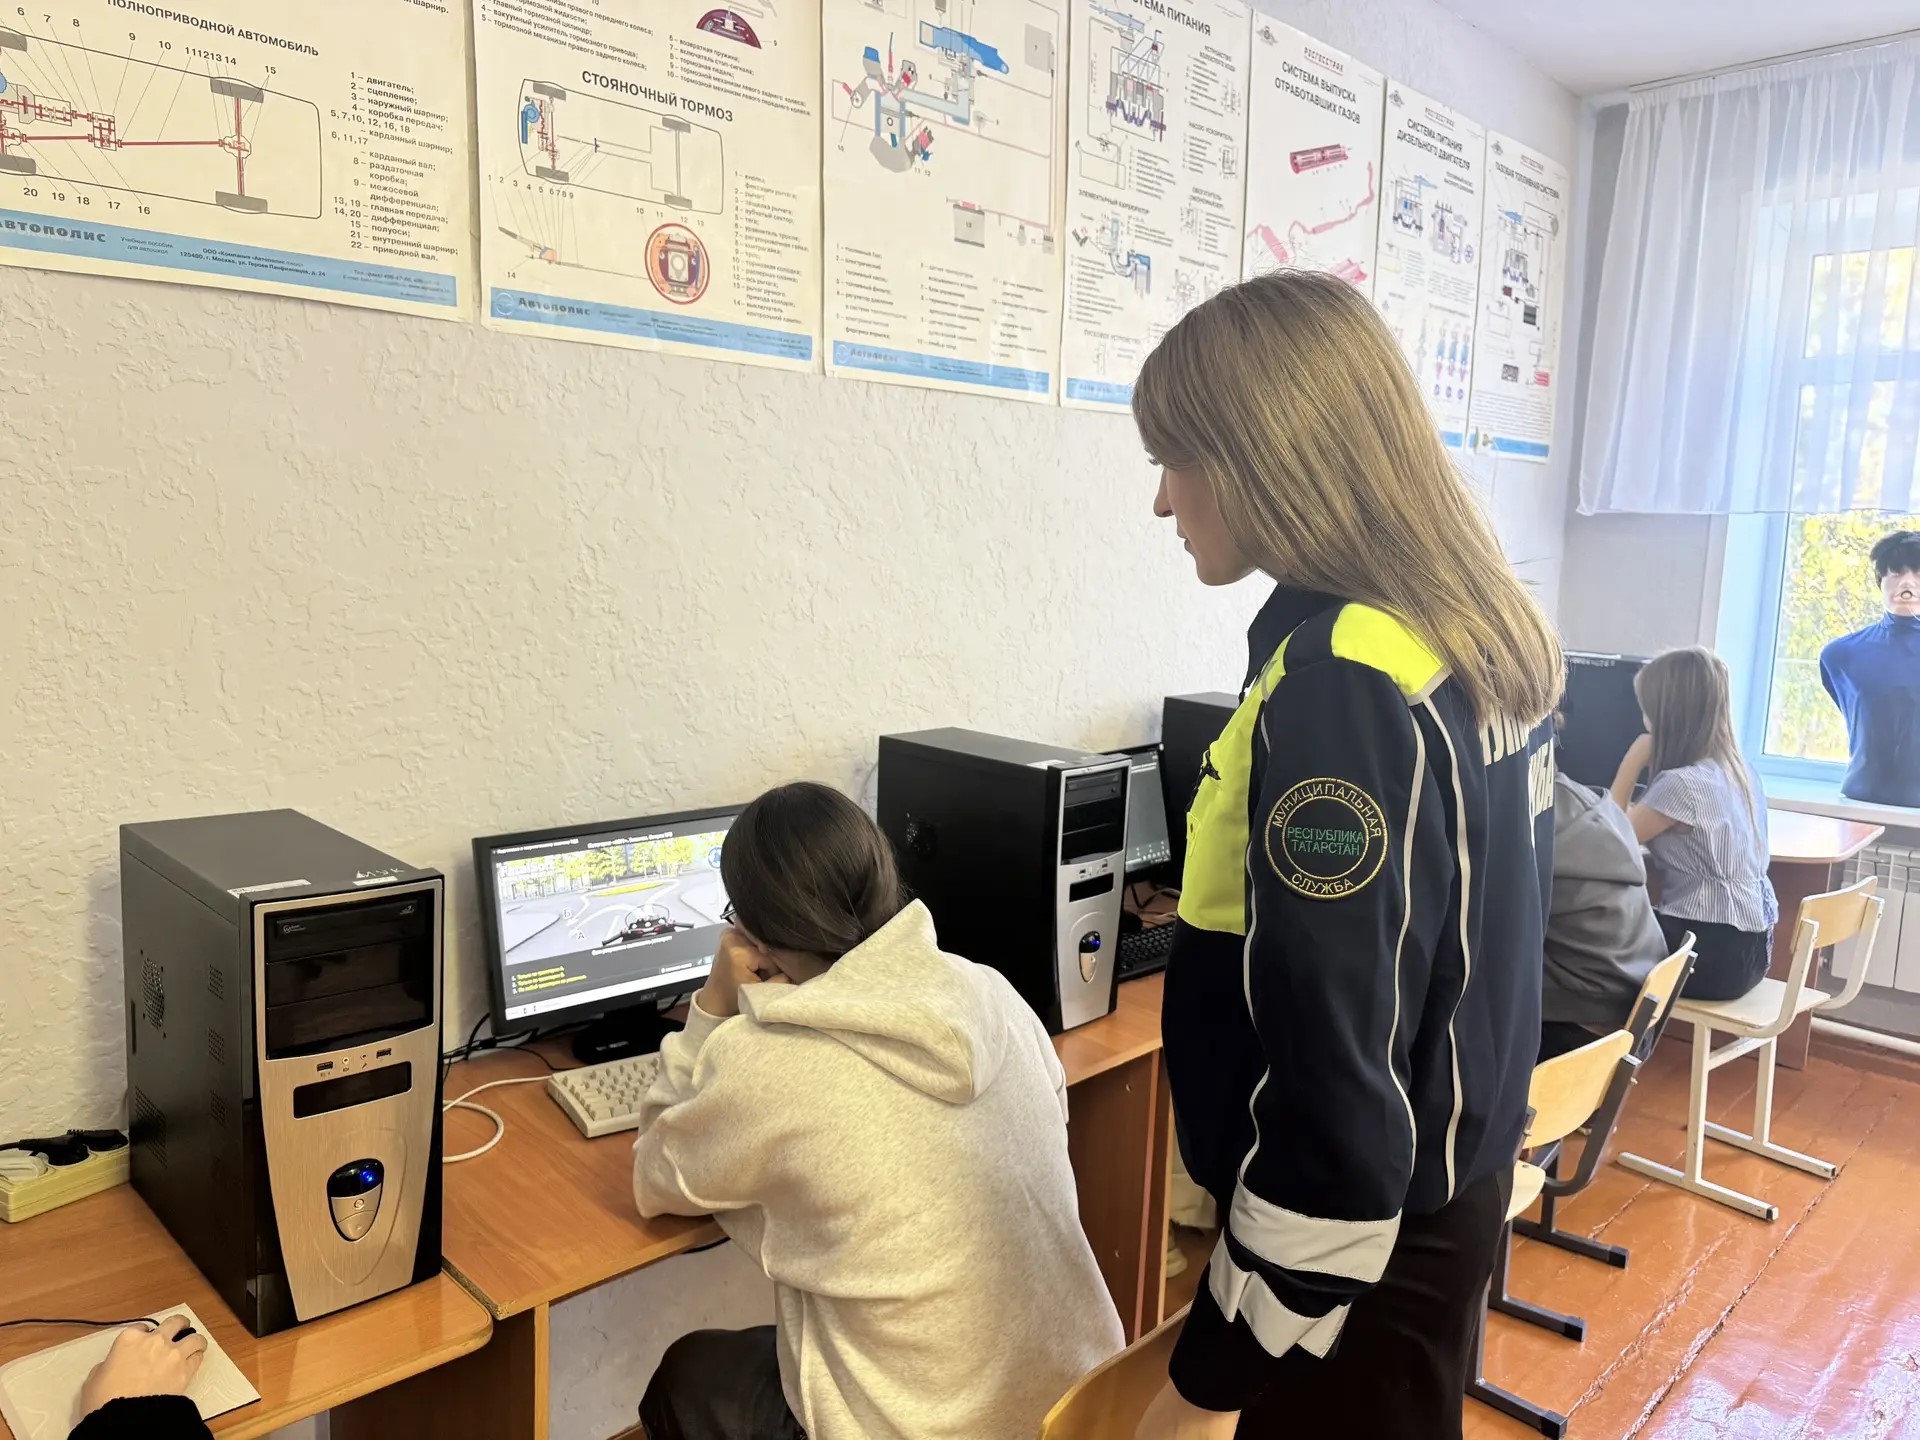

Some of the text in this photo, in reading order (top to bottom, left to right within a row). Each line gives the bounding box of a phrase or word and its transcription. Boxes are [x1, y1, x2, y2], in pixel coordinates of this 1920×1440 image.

[17, 7, 25, 16] 6
[43, 14, 51, 23] 7
[523, 9, 561, 25] тормозной
[72, 18, 80, 27] 8
[493, 9, 533, 26] вакуумный
[569, 32, 608, 50] тормозного
[1167, 7, 1212, 37] ПИТАНИЯ
[128, 32, 136, 41] 9
[158, 40, 172, 50] 10
[237, 29, 319, 57] АВТОМОБИЛЬ
[494, 19, 533, 37] тормозной
[533, 31, 567, 47] механизм
[567, 42, 595, 55] правого
[595, 51, 622, 63] заднего
[210, 53, 222, 62] 13
[225, 56, 237, 65] 14
[264, 65, 277, 75] 15
[366, 77, 414, 94] двигатель;
[1281, 61, 1357, 104] СИСТЕМА ВЫПУСКА
[350, 82, 418, 105] 2 сцепление;
[582, 70, 734, 123] СТОЯНОЧНЫЙ ТОРМОЗ
[1274, 77, 1361, 125] ОТРАБОТАВШИХ ГАЗОВ
[351, 92, 449, 123] 3 наружный шарнир;
[352, 103, 443, 132] 4 коробка передач;
[400, 125, 411, 133] 18
[368, 129, 453, 155] карданный шарнир;
[353, 157, 424, 178] 8 раздаточная
[369, 151, 436, 171] карданный вал;
[353, 178, 419, 198] 9 межосевой
[369, 172, 408, 186] коробка;
[23, 187, 38, 197] 20
[51, 192, 66, 202] 19
[76, 196, 90, 206] 18
[107, 201, 121, 210] 17
[137, 205, 151, 215] 16
[350, 199, 361, 207] 19
[370, 203, 405, 216] главная
[405, 210, 449, 224] передача;
[369, 193, 439, 212] дифференциал;
[350, 209, 361, 218] 20
[371, 214, 440, 232] дифференциал;
[350, 220, 411, 238] 15 полуоси;
[350, 230, 459, 256] 21 внутренний шарнир;
[350, 241, 438, 261] 22 приводной вал.
[507, 271, 516, 279] 14
[1271, 783, 1382, 839] МУНИЦИПАЛЬНАЯ
[1287, 826, 1365, 844] РЕСПУБЛИКА
[1291, 839, 1360, 856] ТАТАРСТАН
[1291, 872, 1354, 895] СЛУЖБА
